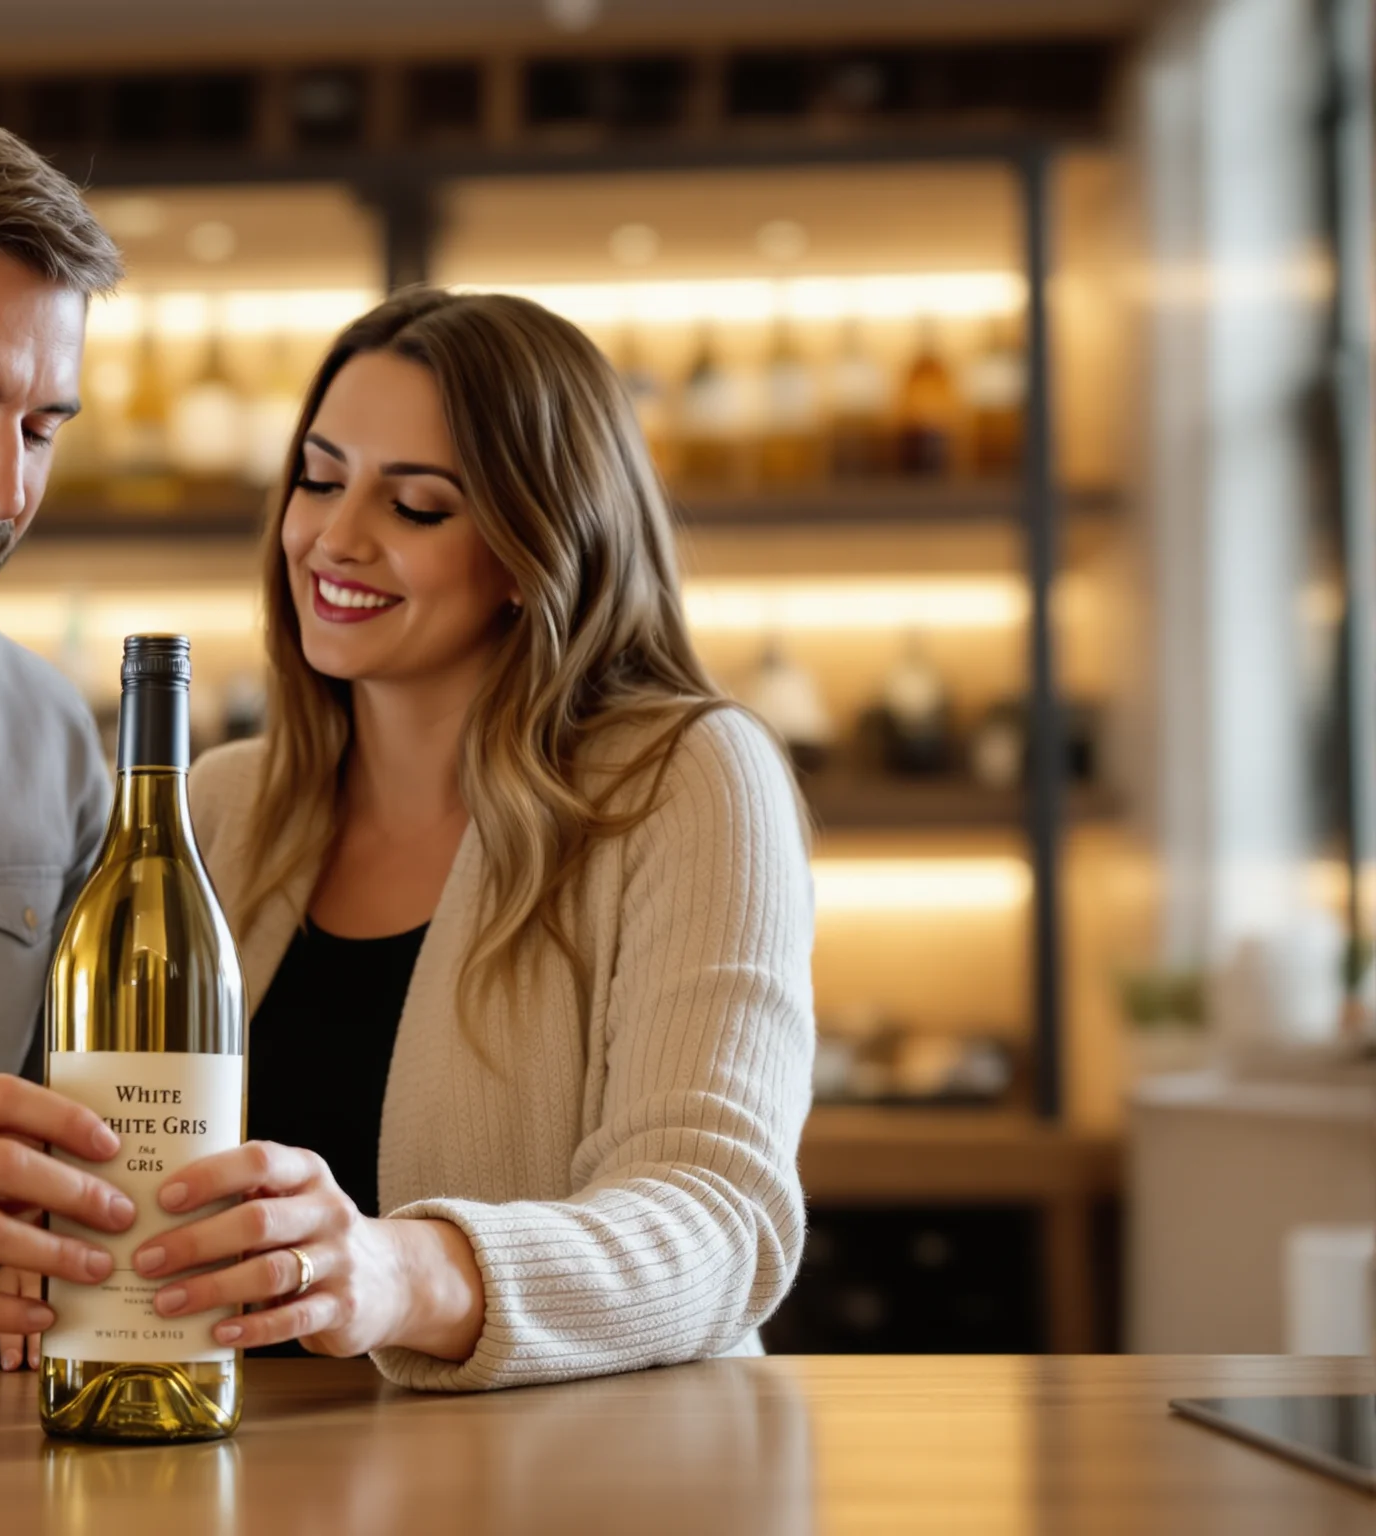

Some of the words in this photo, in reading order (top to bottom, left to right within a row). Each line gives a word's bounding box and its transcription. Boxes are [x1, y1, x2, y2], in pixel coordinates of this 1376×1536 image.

[102, 1117, 157, 1134] HITE
[163, 1116, 207, 1135] GRIS
[127, 1159, 164, 1172] GRIS
